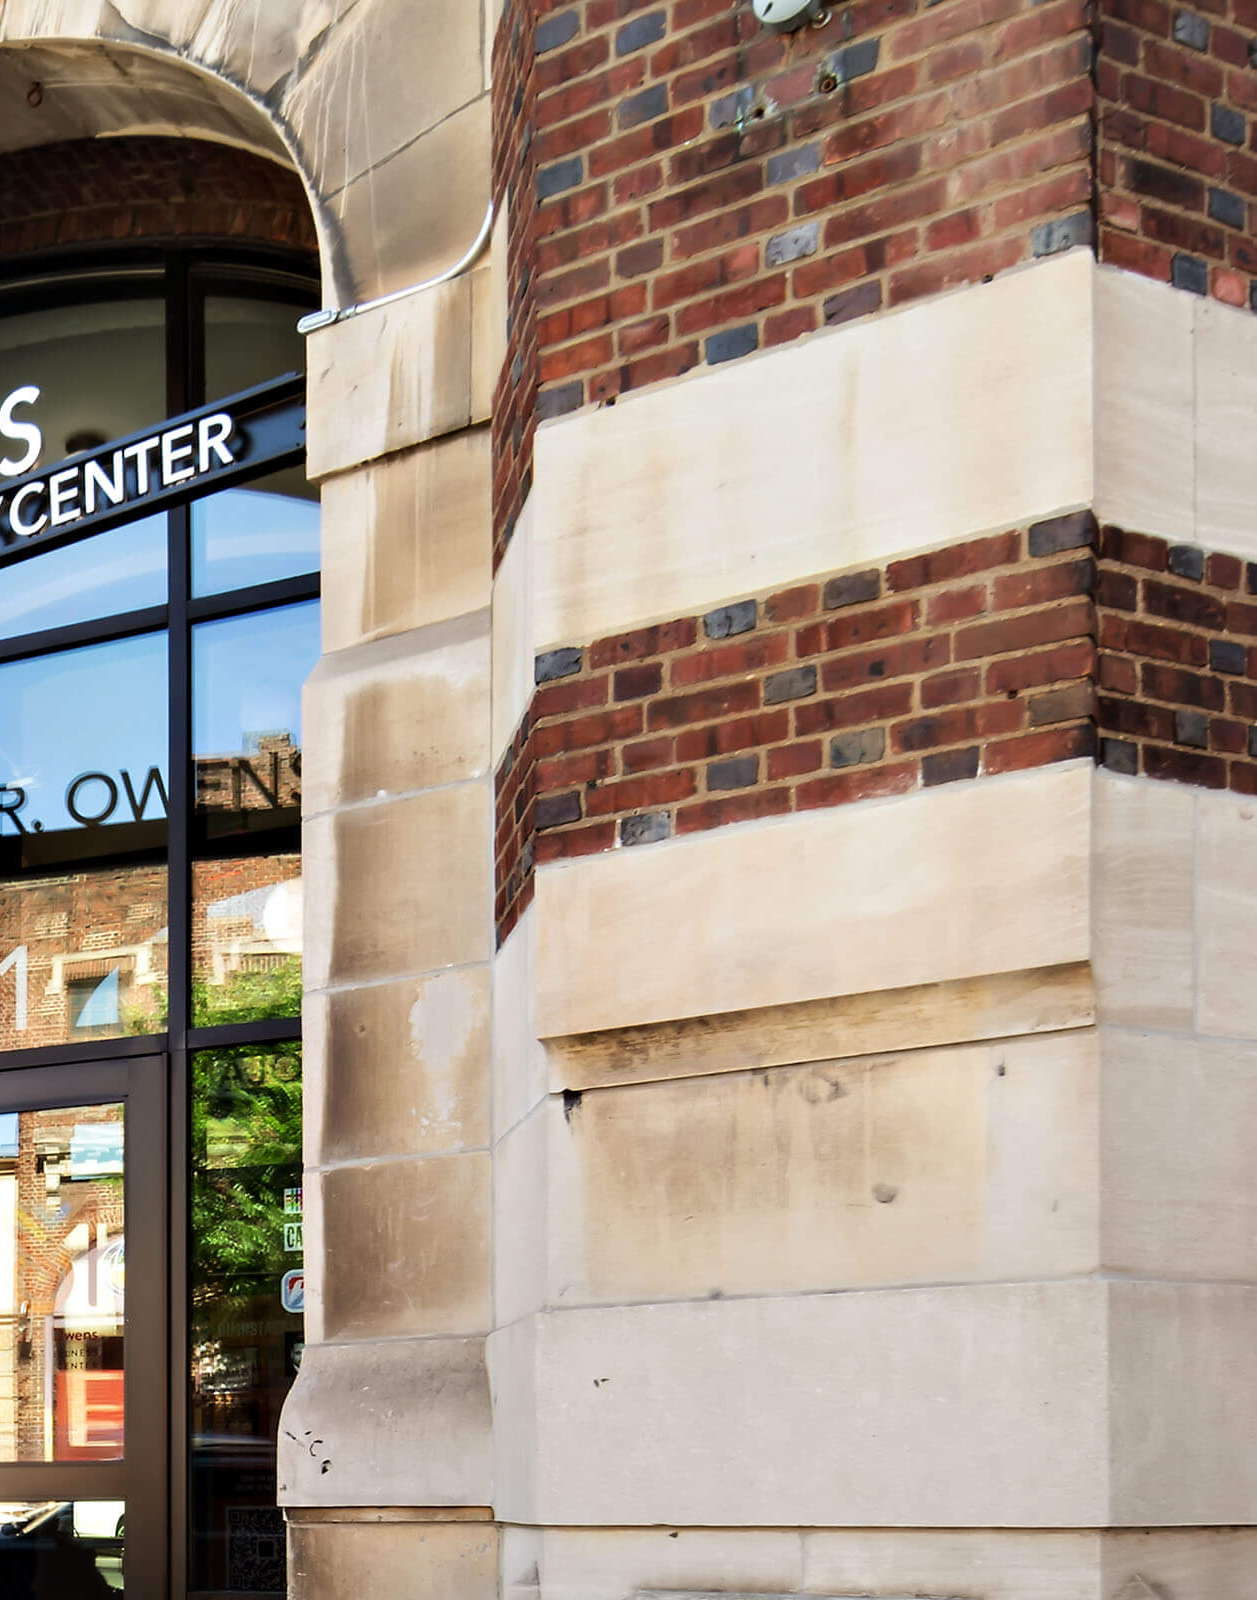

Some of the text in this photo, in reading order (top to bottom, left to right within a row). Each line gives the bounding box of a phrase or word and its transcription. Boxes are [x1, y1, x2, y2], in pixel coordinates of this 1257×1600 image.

[9, 413, 234, 537] CENTER
[287, 1226, 302, 1248] CA
[55, 1328, 98, 1341] wens
